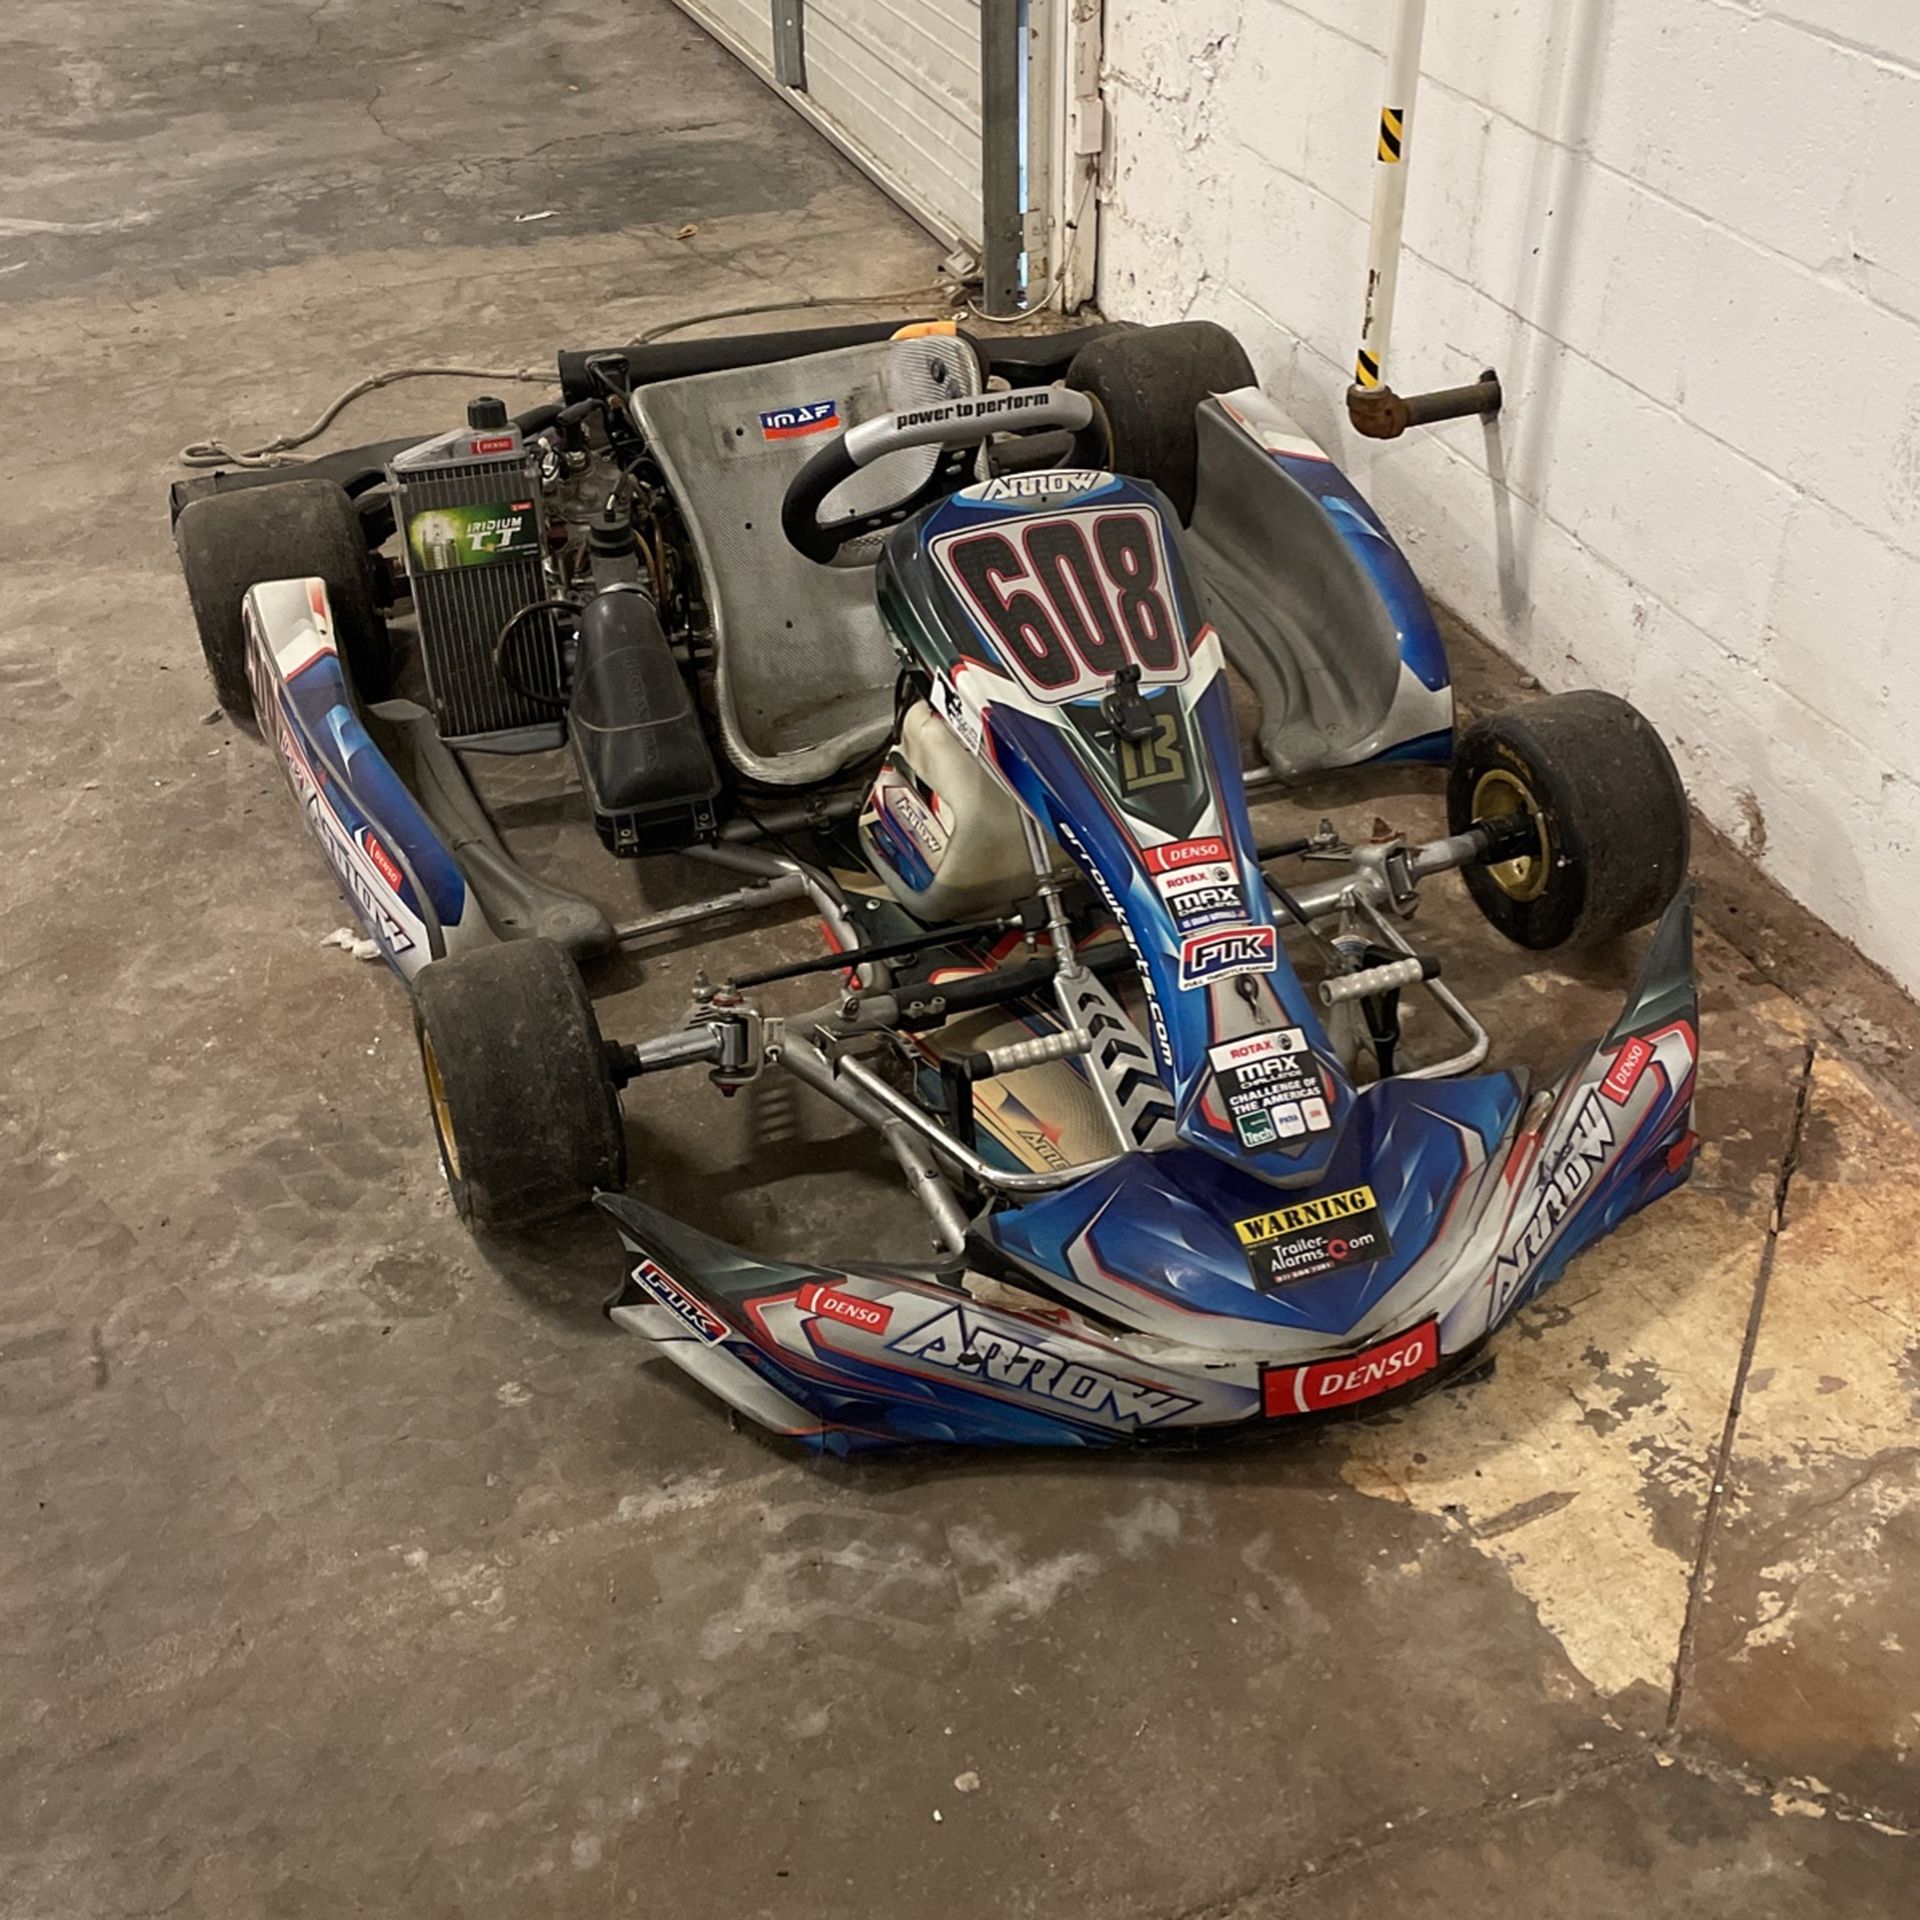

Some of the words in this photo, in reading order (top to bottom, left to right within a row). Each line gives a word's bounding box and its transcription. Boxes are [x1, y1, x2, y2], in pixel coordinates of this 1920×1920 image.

[767, 403, 831, 428] IMAF
[897, 407, 953, 430] power
[956, 403, 973, 418] to
[976, 392, 1049, 417] perform
[482, 440, 509, 450] DENSO
[982, 471, 1101, 502] ARROW
[466, 527, 522, 551] TT
[467, 516, 523, 534] IRIDIUM
[948, 513, 1178, 690] 608
[896, 796, 942, 853] ARROW
[374, 850, 398, 884] DENSO
[1169, 844, 1220, 862] DENSO
[1166, 872, 1208, 889] ROTAX
[1173, 887, 1239, 911] MAX
[1058, 822, 1174, 1067] arrowkarts.com
[1191, 933, 1268, 973] FTK
[1230, 1040, 1273, 1059] ROTAX
[1235, 1055, 1299, 1083] MAX
[1616, 1044, 1643, 1085] DENSO
[1229, 1080, 1302, 1106] CHALLENGE
[1303, 1077, 1317, 1088] OF
[1231, 1100, 1260, 1115] THE
[1262, 1086, 1321, 1108] AMERICAS
[1245, 1126, 1274, 1144] Tech
[1244, 1190, 1367, 1240] WARNING
[1486, 1087, 1616, 1335] ARROW
[1271, 1235, 1328, 1258] Trailer-
[645, 1270, 718, 1337] FTK
[822, 1297, 881, 1325] DENSO
[884, 1303, 1203, 1428] ARROW
[1318, 1341, 1424, 1396] DENSO
